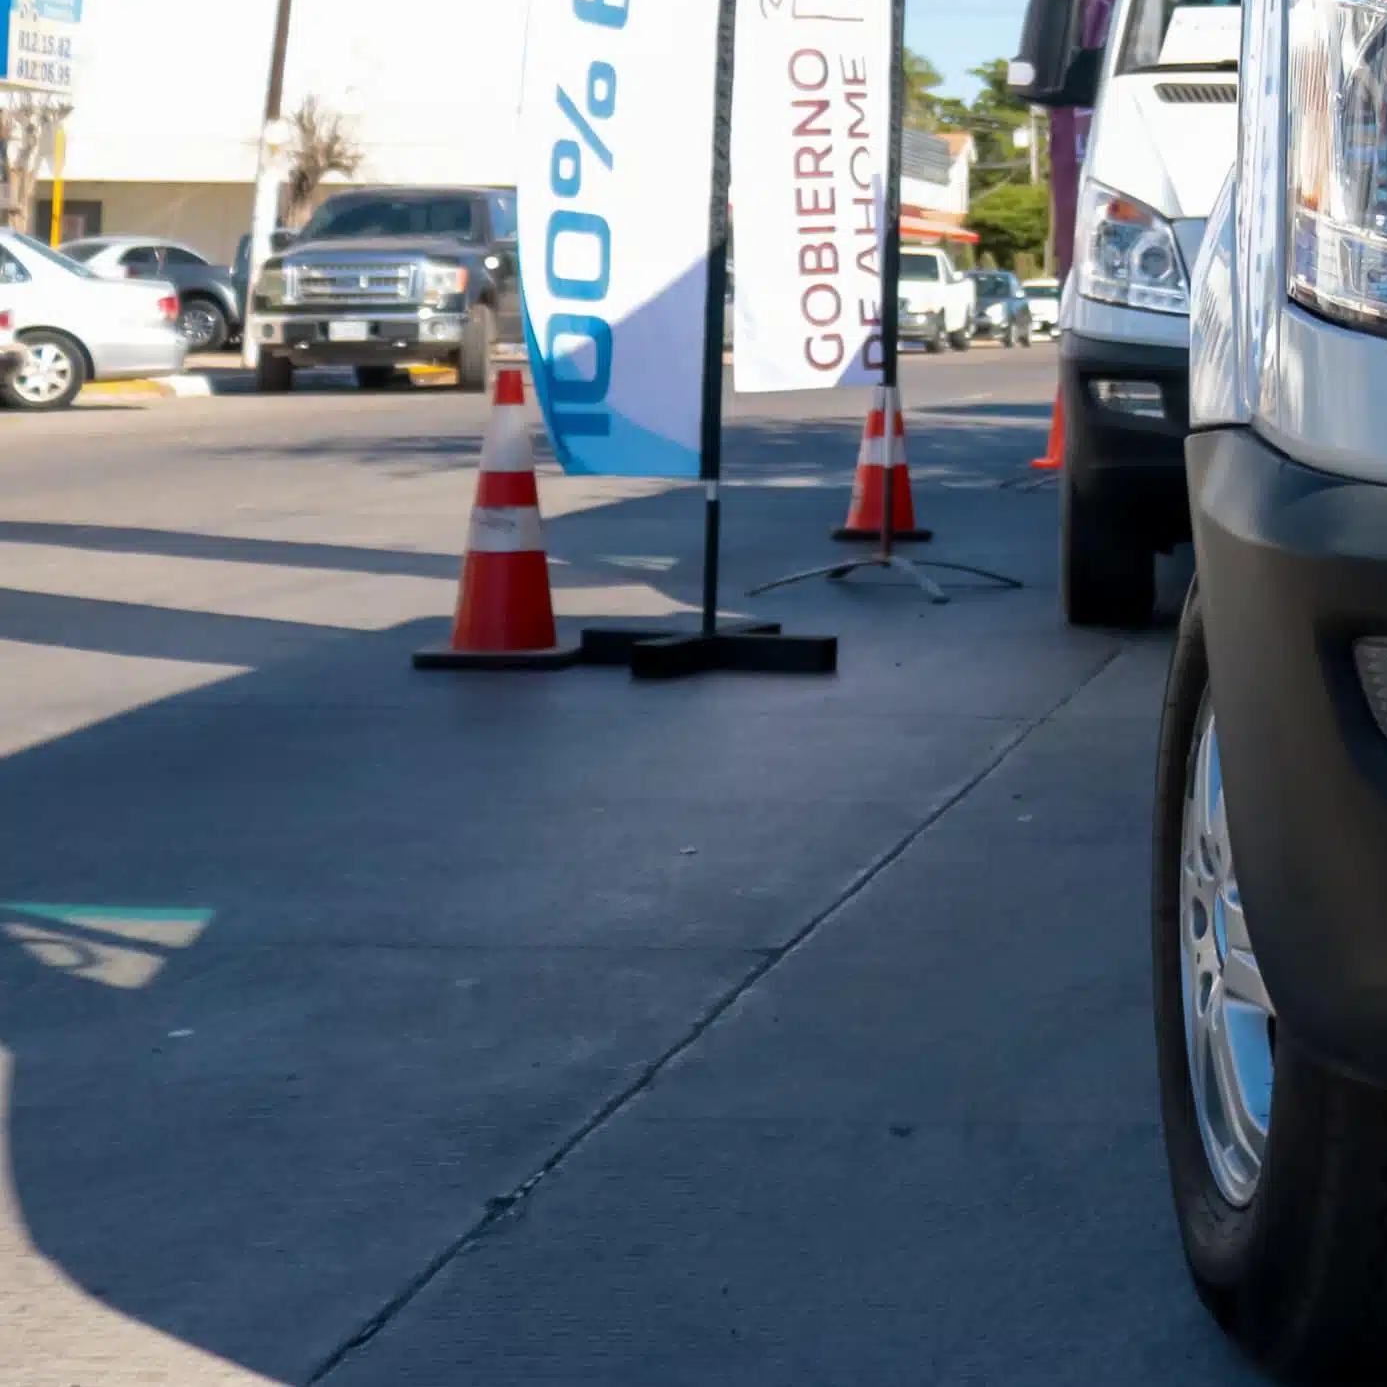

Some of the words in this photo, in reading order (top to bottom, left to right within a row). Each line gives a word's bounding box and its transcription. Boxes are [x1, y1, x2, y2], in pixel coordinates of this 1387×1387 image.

[544, 60, 618, 438] 100%
[787, 47, 845, 372] GOBIERNO
[839, 53, 881, 278] AHOME
